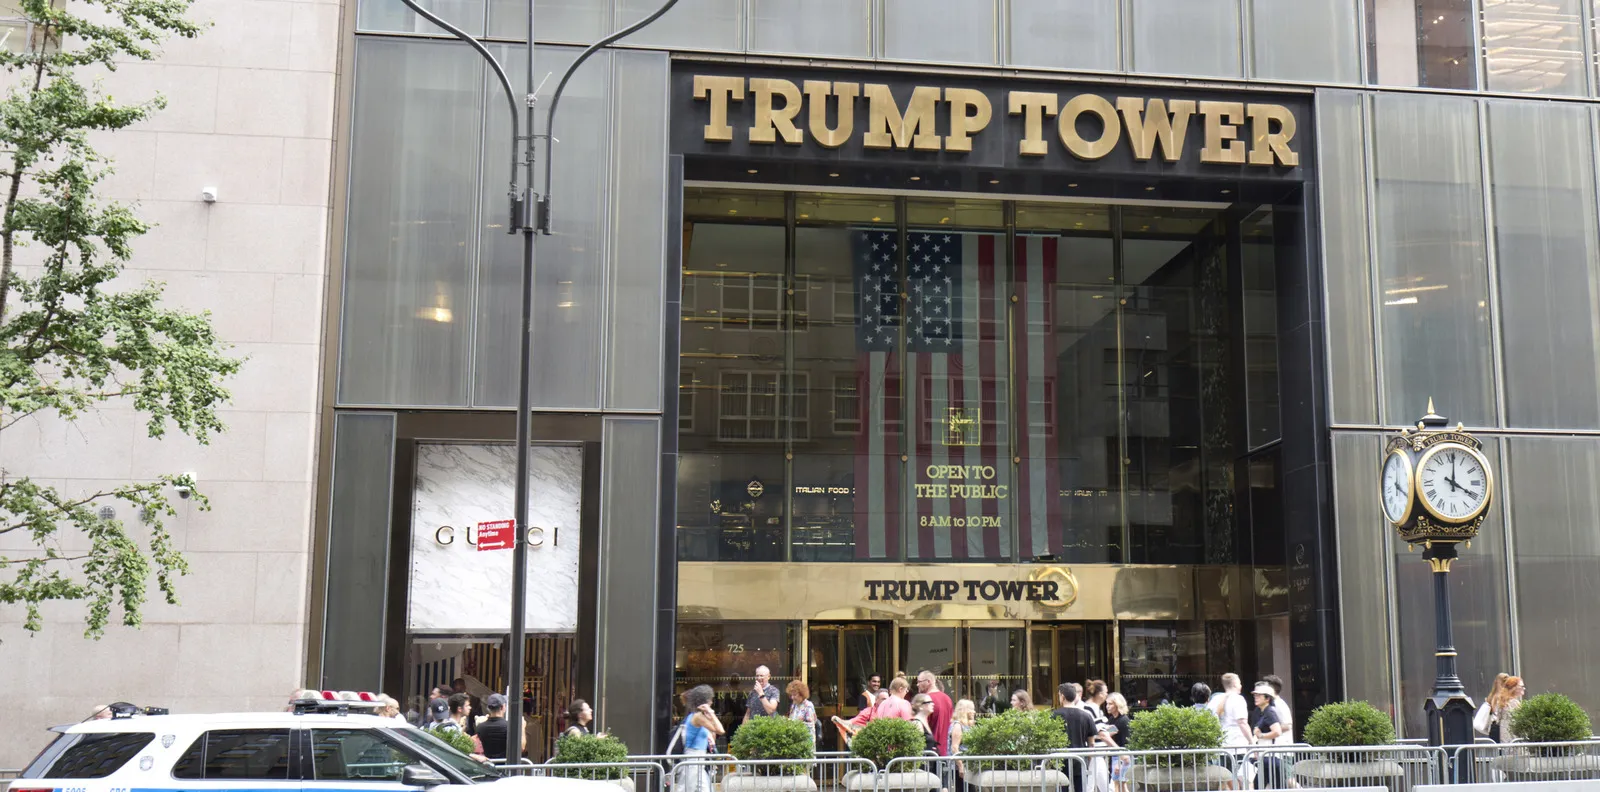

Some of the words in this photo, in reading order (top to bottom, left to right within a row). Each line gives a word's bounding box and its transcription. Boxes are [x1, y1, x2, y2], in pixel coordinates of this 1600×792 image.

[693, 75, 993, 151] TRUMP
[1008, 91, 1299, 166] TOWER
[1425, 433, 1448, 446] TRUMP
[1451, 433, 1474, 446] TOWER
[926, 465, 970, 479] OPEN
[972, 465, 996, 479] TO
[795, 486, 825, 494] ITALIAN
[914, 484, 947, 498] THE
[949, 484, 1008, 499] PUBLIC
[920, 515, 928, 527] 8
[928, 515, 951, 527] AM
[953, 516, 965, 527] to
[966, 516, 981, 527] 10
[981, 516, 1002, 528] PM
[435, 525, 558, 547] GUCI
[864, 579, 959, 601] TRUMP
[963, 580, 1060, 601] TOWER
[727, 643, 744, 653] 725
